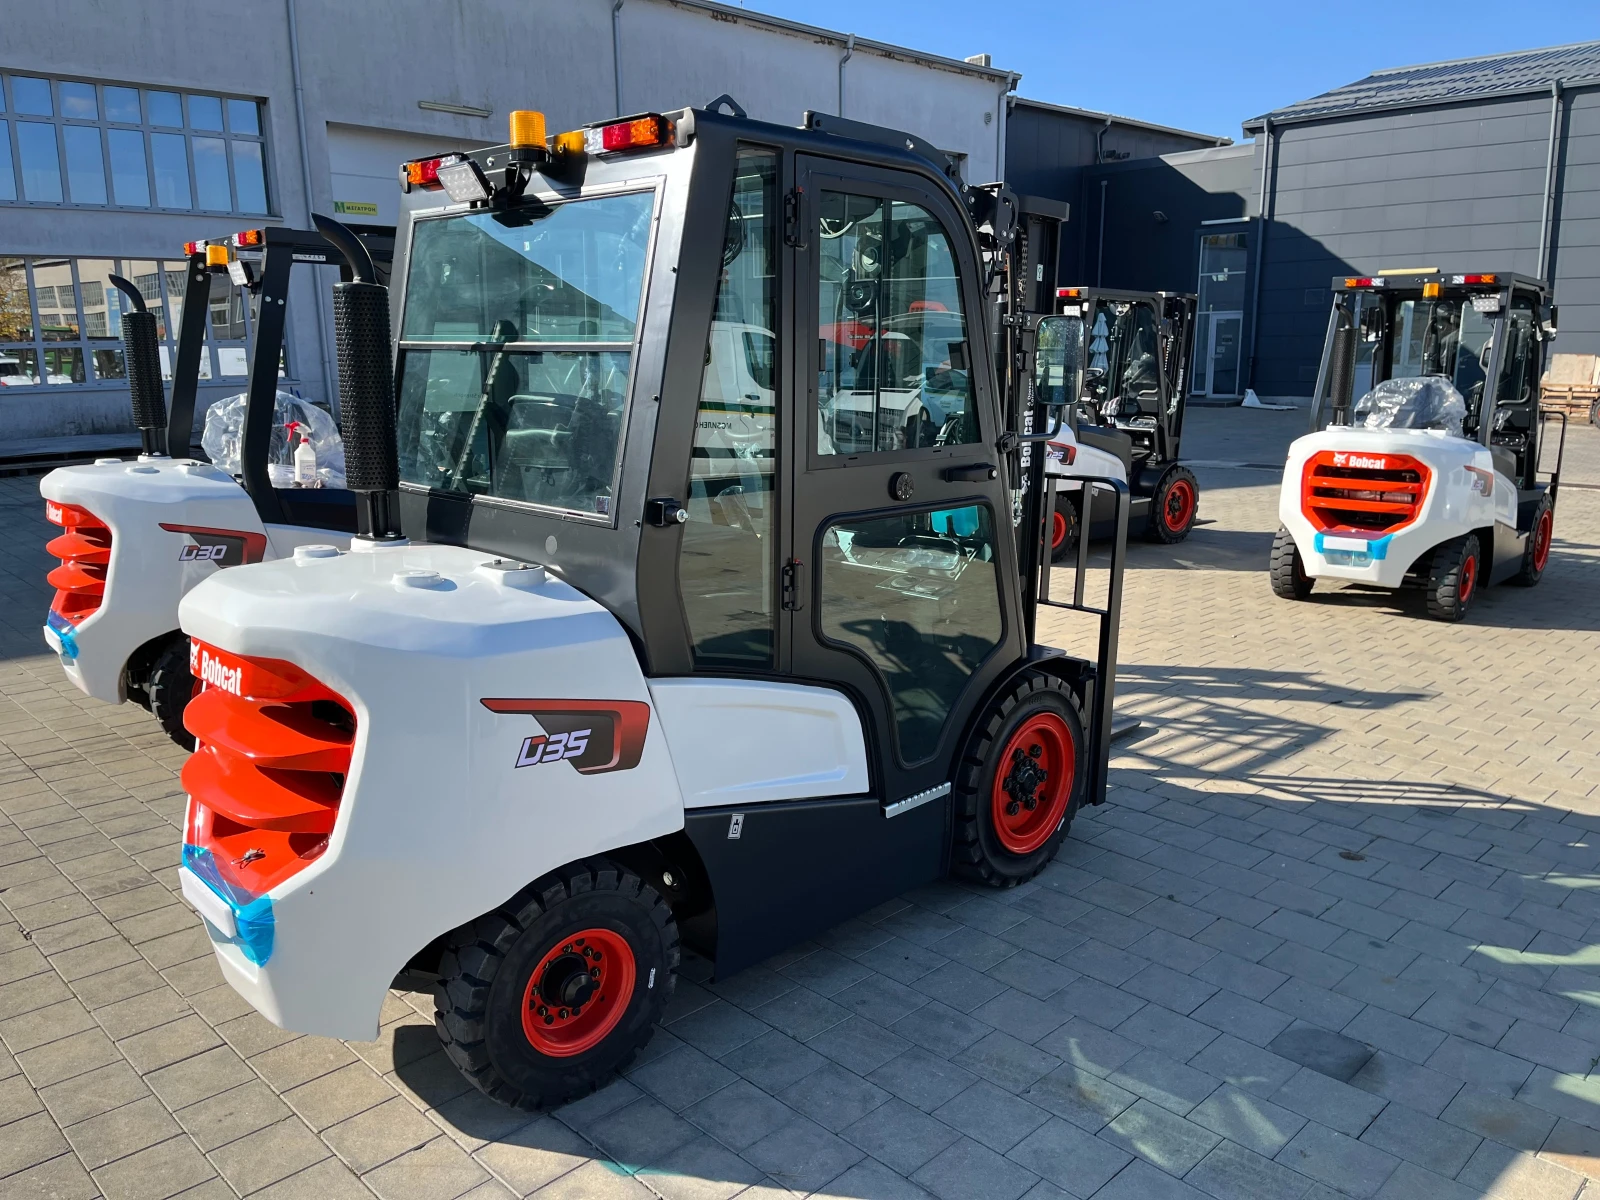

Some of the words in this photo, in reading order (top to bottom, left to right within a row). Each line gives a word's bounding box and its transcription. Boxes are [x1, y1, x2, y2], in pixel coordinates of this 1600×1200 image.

[1349, 455, 1386, 470] Bobcat
[179, 545, 228, 561] D30
[201, 649, 242, 697] Bobcat
[515, 728, 592, 768] D35
